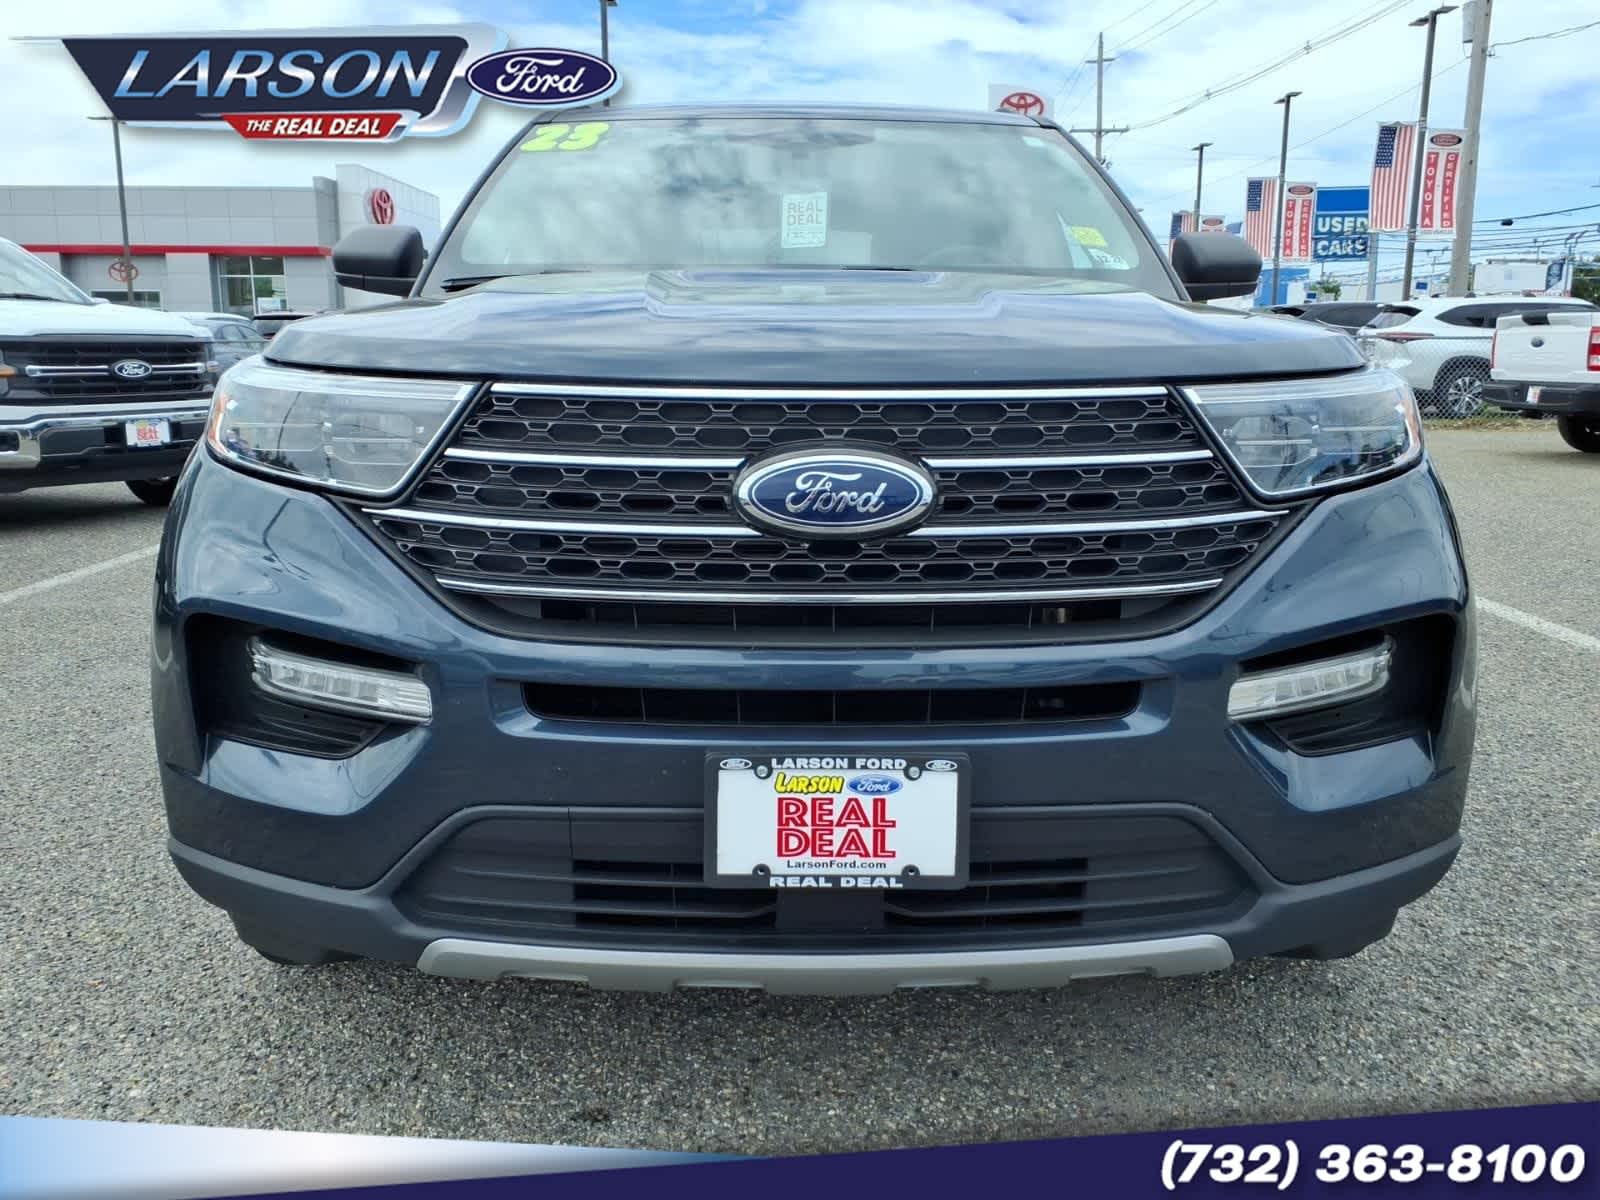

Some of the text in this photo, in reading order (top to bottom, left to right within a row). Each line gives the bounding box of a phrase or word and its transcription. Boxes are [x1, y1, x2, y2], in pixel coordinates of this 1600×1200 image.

[520, 122, 611, 153] 23
[1423, 154, 1437, 226] TOYOTA
[1442, 154, 1457, 227] CERTIFIED
[787, 200, 823, 214] REAL
[787, 214, 823, 226] DEAL
[1317, 217, 1369, 233] USED
[1317, 239, 1367, 256] CARS
[785, 470, 888, 514] Ford
[771, 758, 907, 770] LARSON FORD
[857, 777, 890, 792] Ford
[777, 797, 896, 828] REAL
[777, 828, 896, 858] DEAL
[787, 860, 887, 870] LarsonFord.com
[769, 876, 904, 888] REAL DEAL
